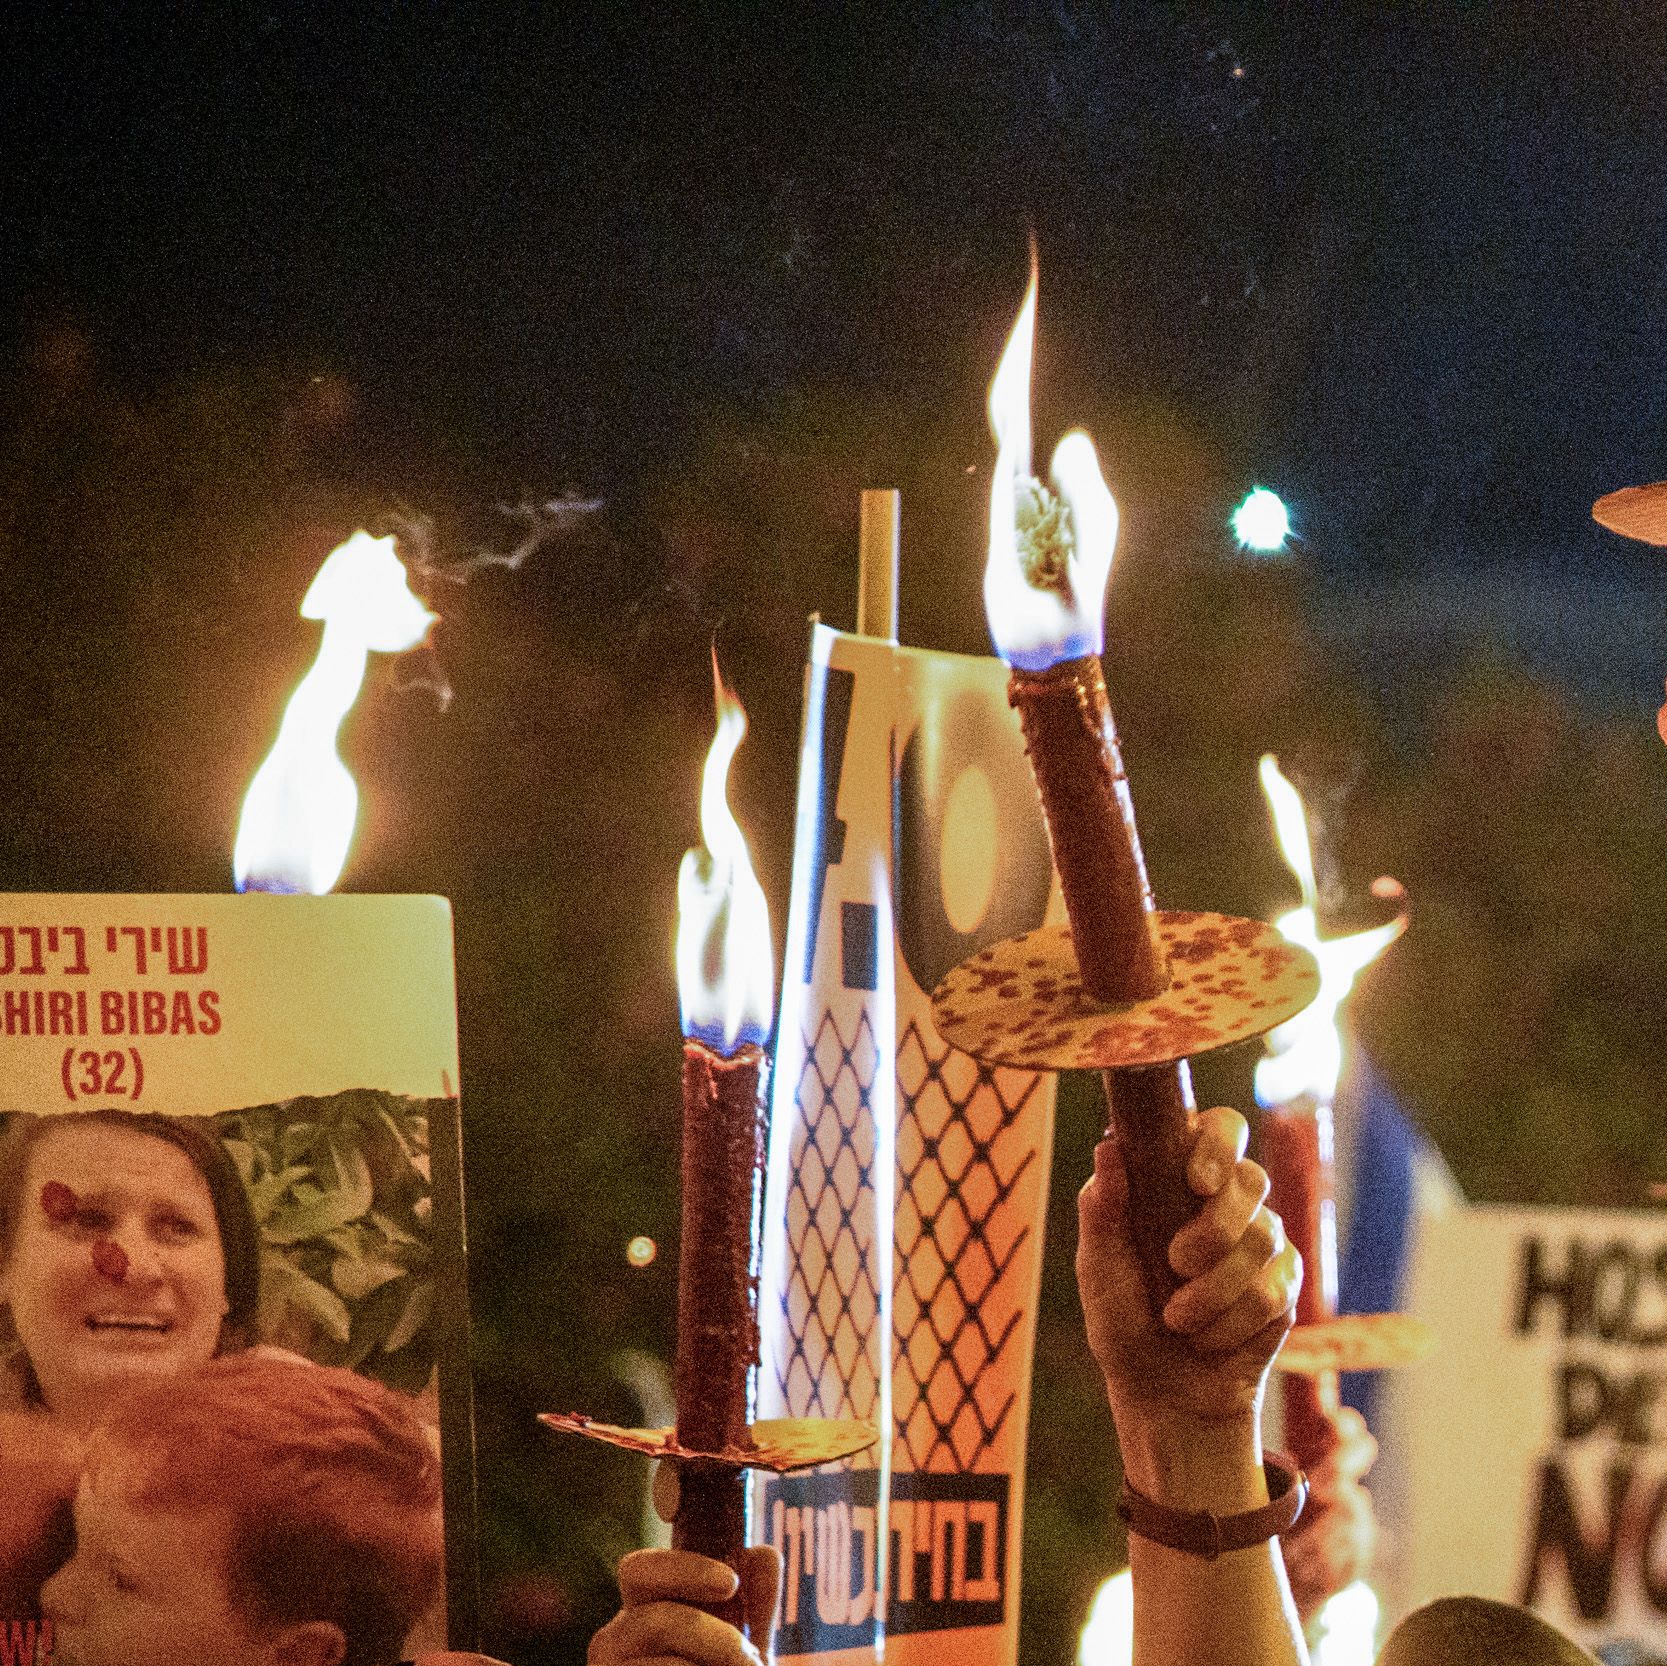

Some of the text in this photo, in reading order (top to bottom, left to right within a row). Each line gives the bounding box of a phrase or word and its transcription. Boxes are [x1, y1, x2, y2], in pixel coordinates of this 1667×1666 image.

[106, 927, 208, 975] שירי
[0, 990, 222, 1036] HIRI BIBAS
[61, 1048, 144, 1102] (32)
